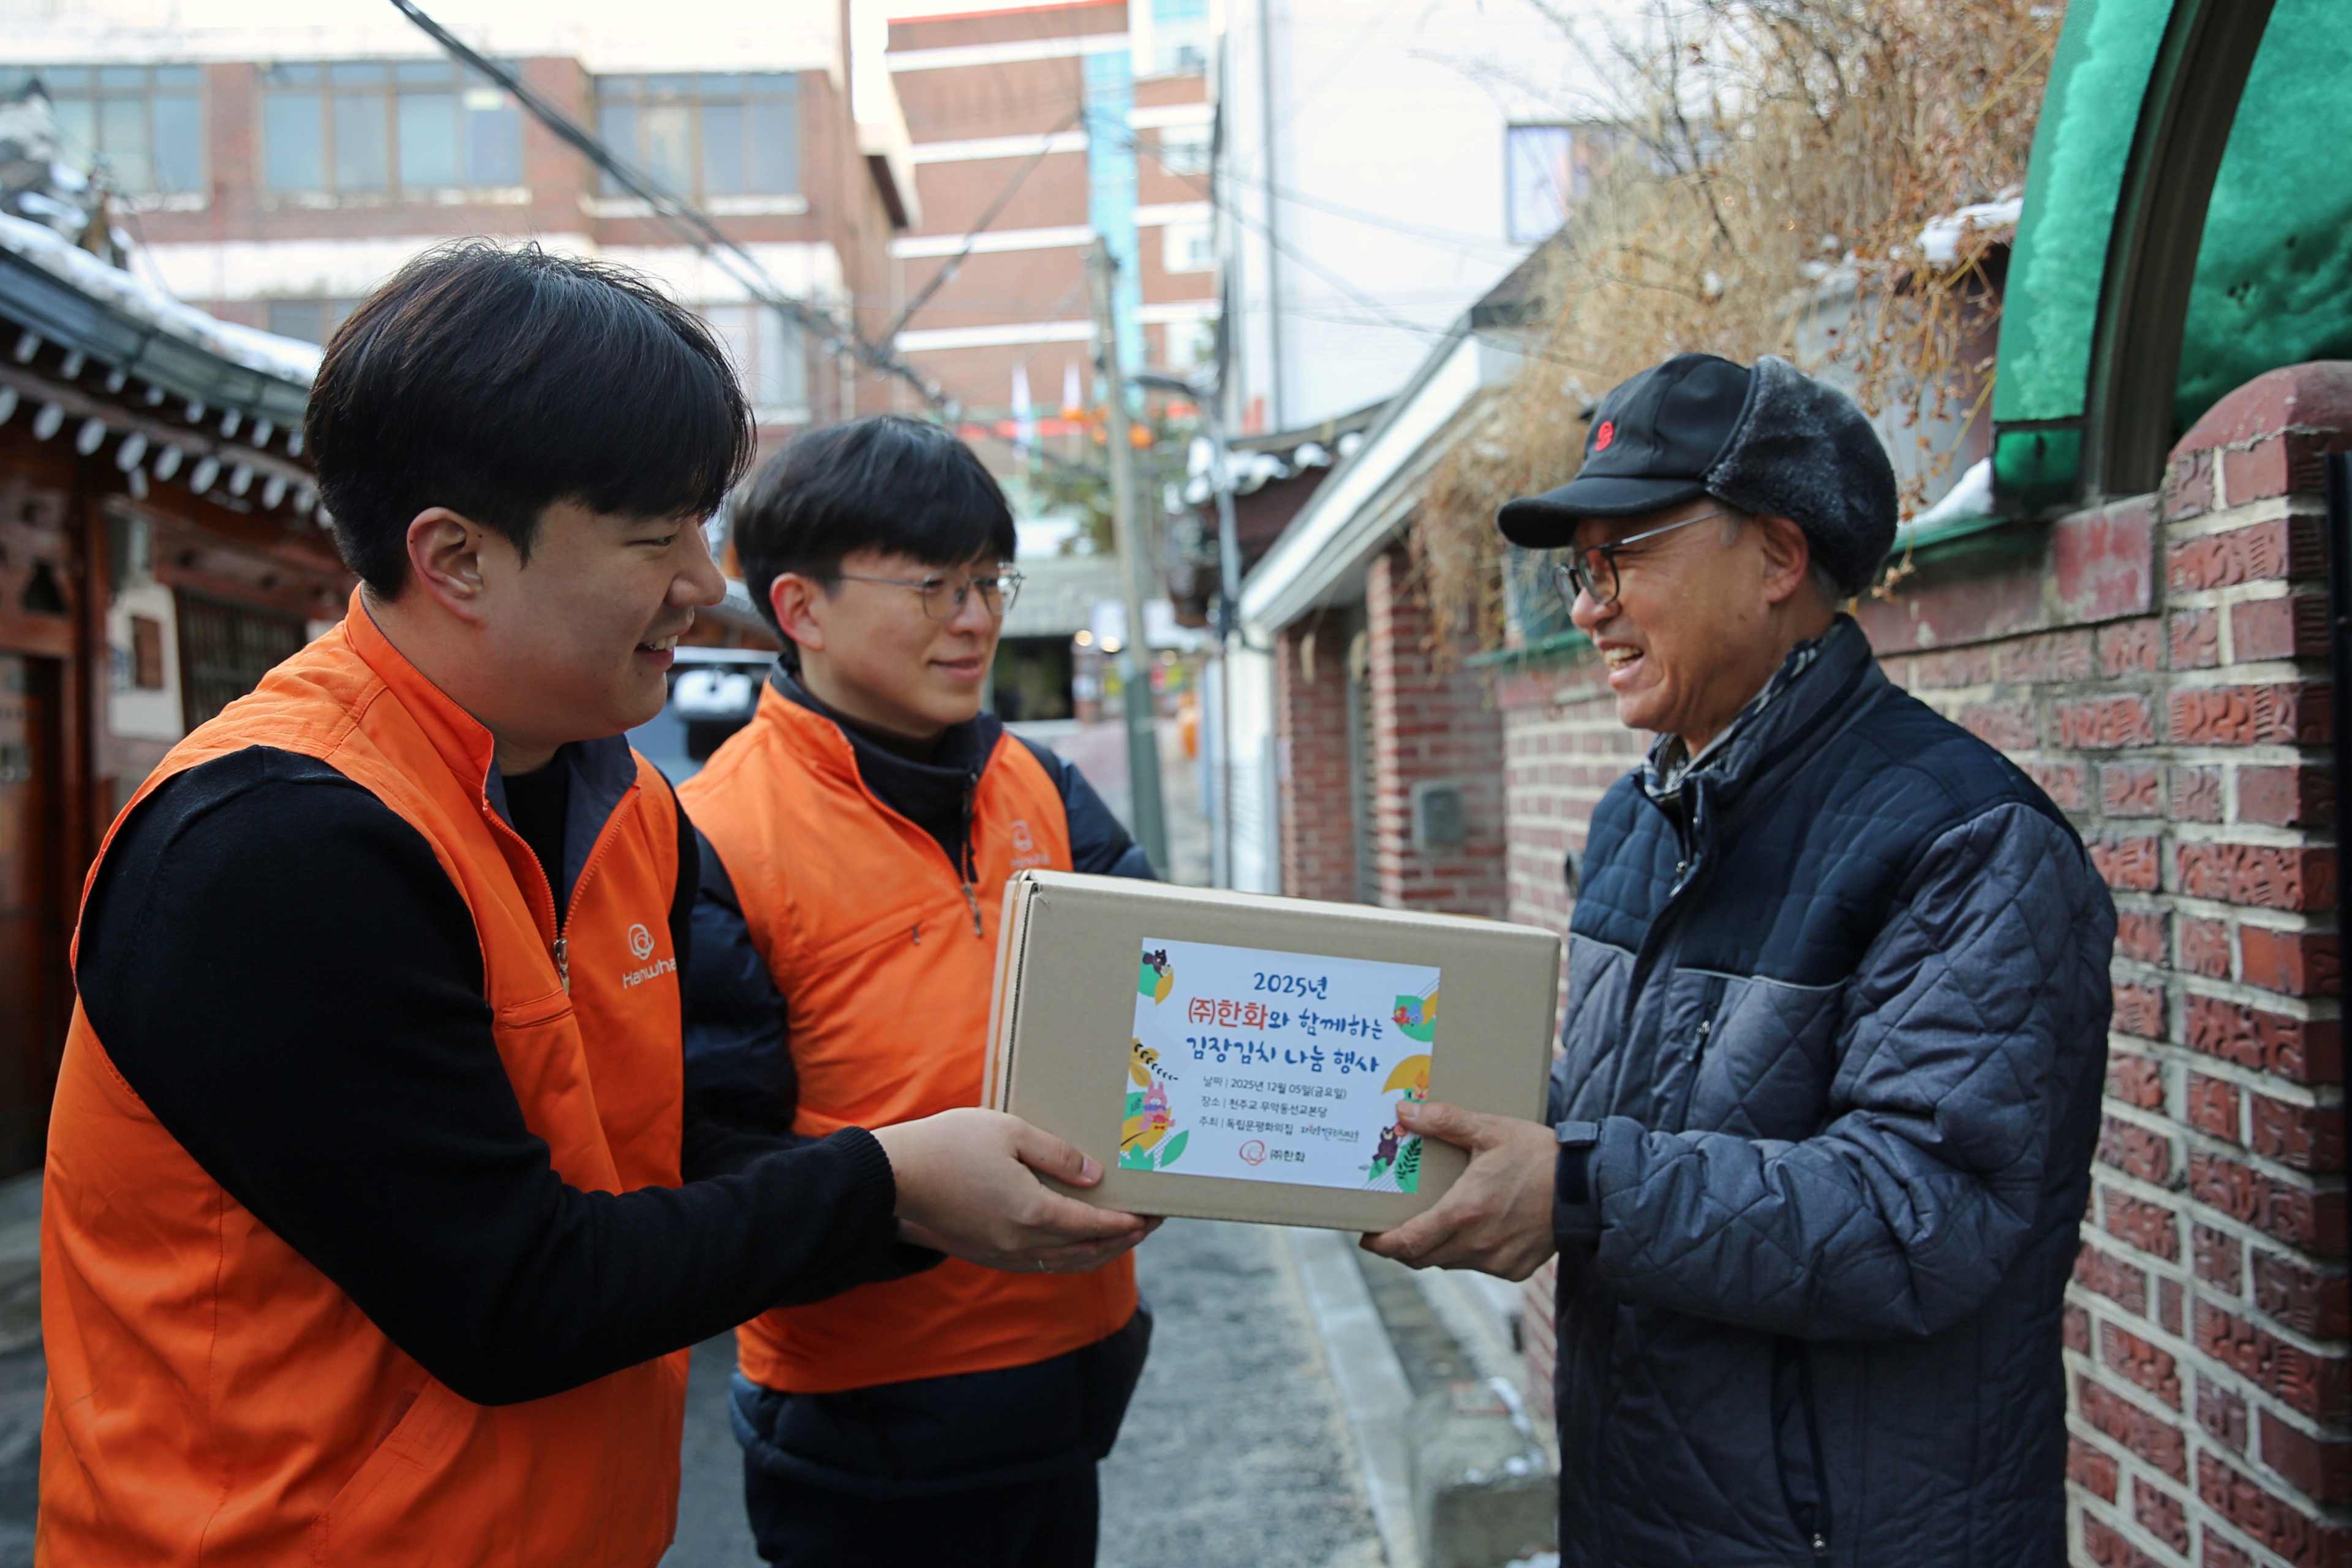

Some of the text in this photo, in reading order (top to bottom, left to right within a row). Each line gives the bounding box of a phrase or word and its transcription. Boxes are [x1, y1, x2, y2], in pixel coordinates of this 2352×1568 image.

[622, 957, 677, 989] Hanwha
[1254, 972, 1328, 1000] 2025년
[1298, 1008, 1383, 1040] 함께하는
[1186, 1036, 1380, 1074] 김장김치 나눔 행사
[1231, 1078, 1264, 1091] 2025년
[1267, 1082, 1287, 1095] 12월
[1289, 1083, 1347, 1099] 05일(금요일)
[1201, 1096, 1220, 1107] 장소
[1229, 1098, 1257, 1110] 천주교
[1199, 1115, 1218, 1127] 주최
[1226, 1118, 1293, 1135] 독립문평화의집
